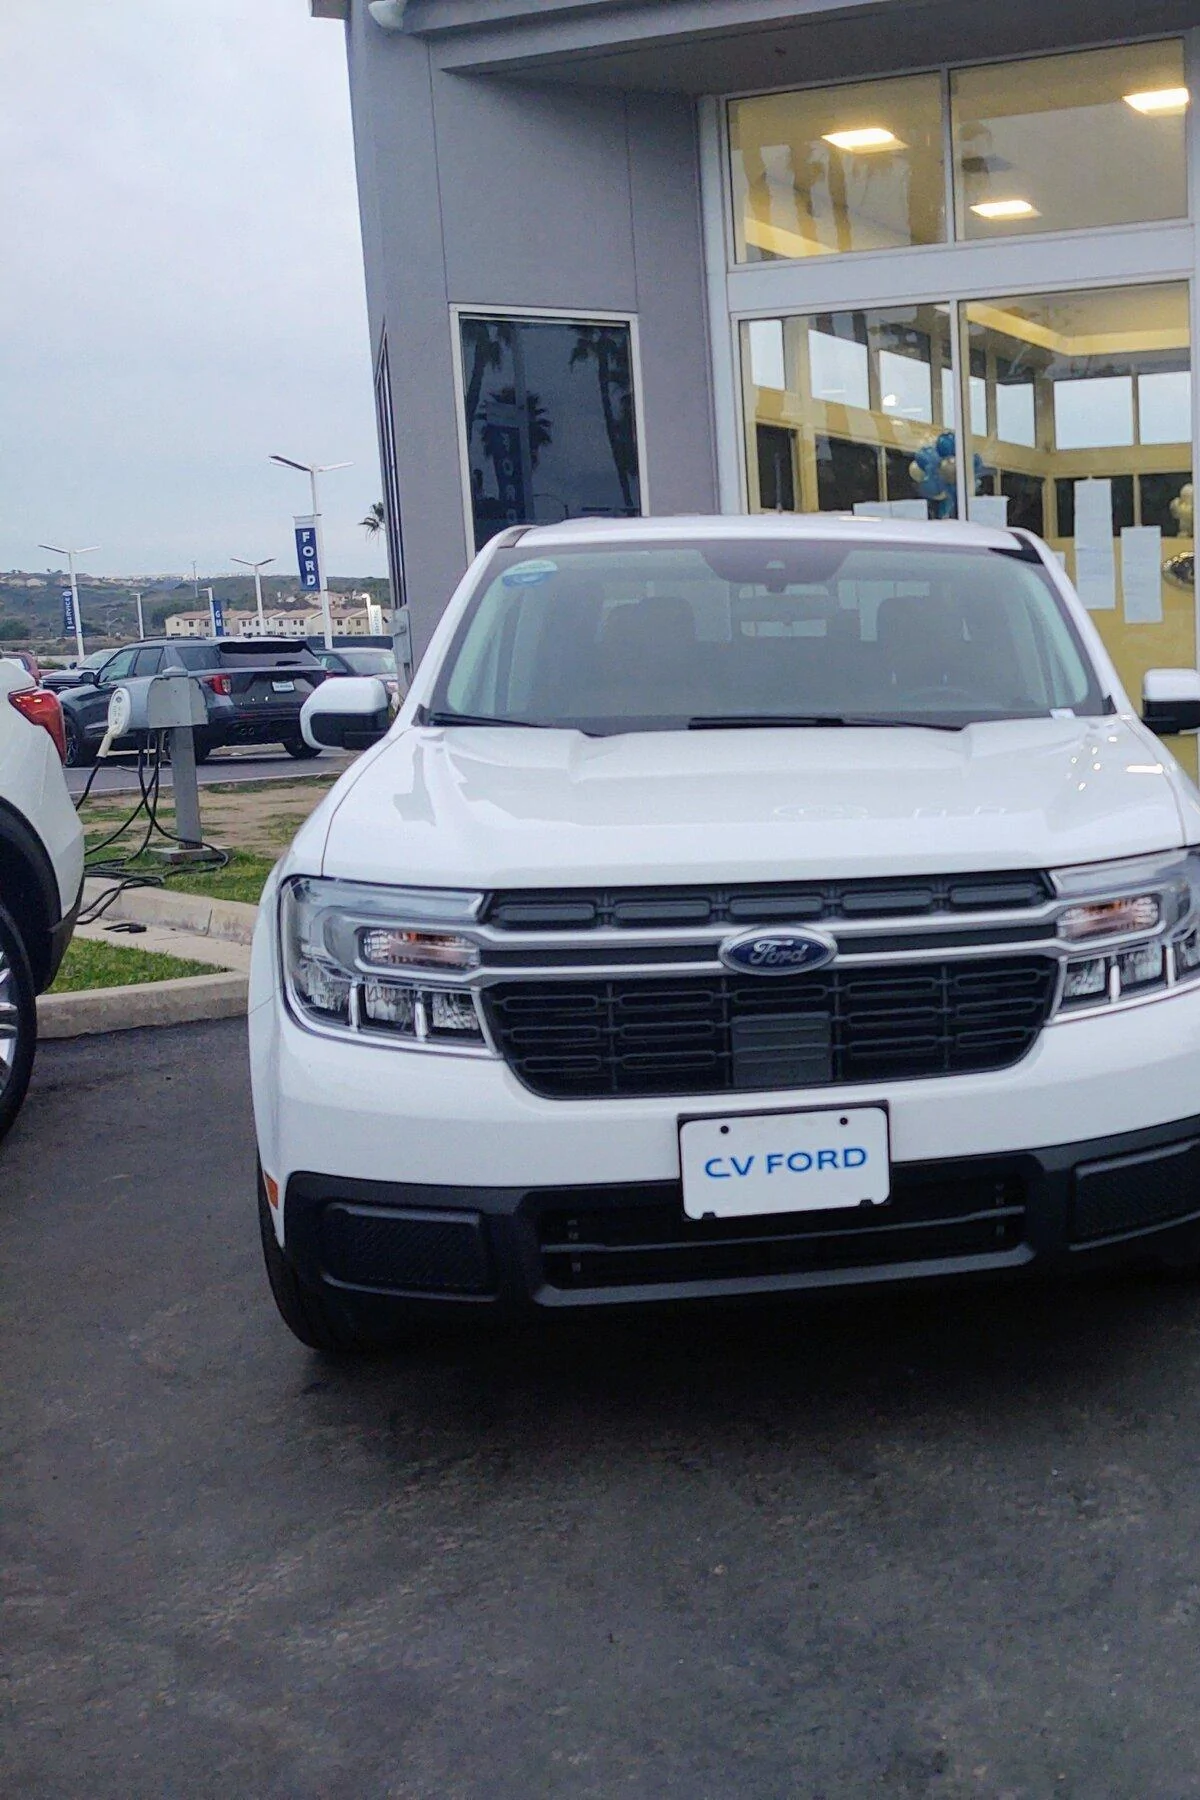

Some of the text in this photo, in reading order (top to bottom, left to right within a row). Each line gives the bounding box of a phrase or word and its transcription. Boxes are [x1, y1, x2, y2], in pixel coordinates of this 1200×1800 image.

[302, 531, 316, 586] FORD
[65, 597, 73, 625] SERVICE
[748, 939, 810, 965] Ford
[704, 1147, 867, 1179] CV FORD
